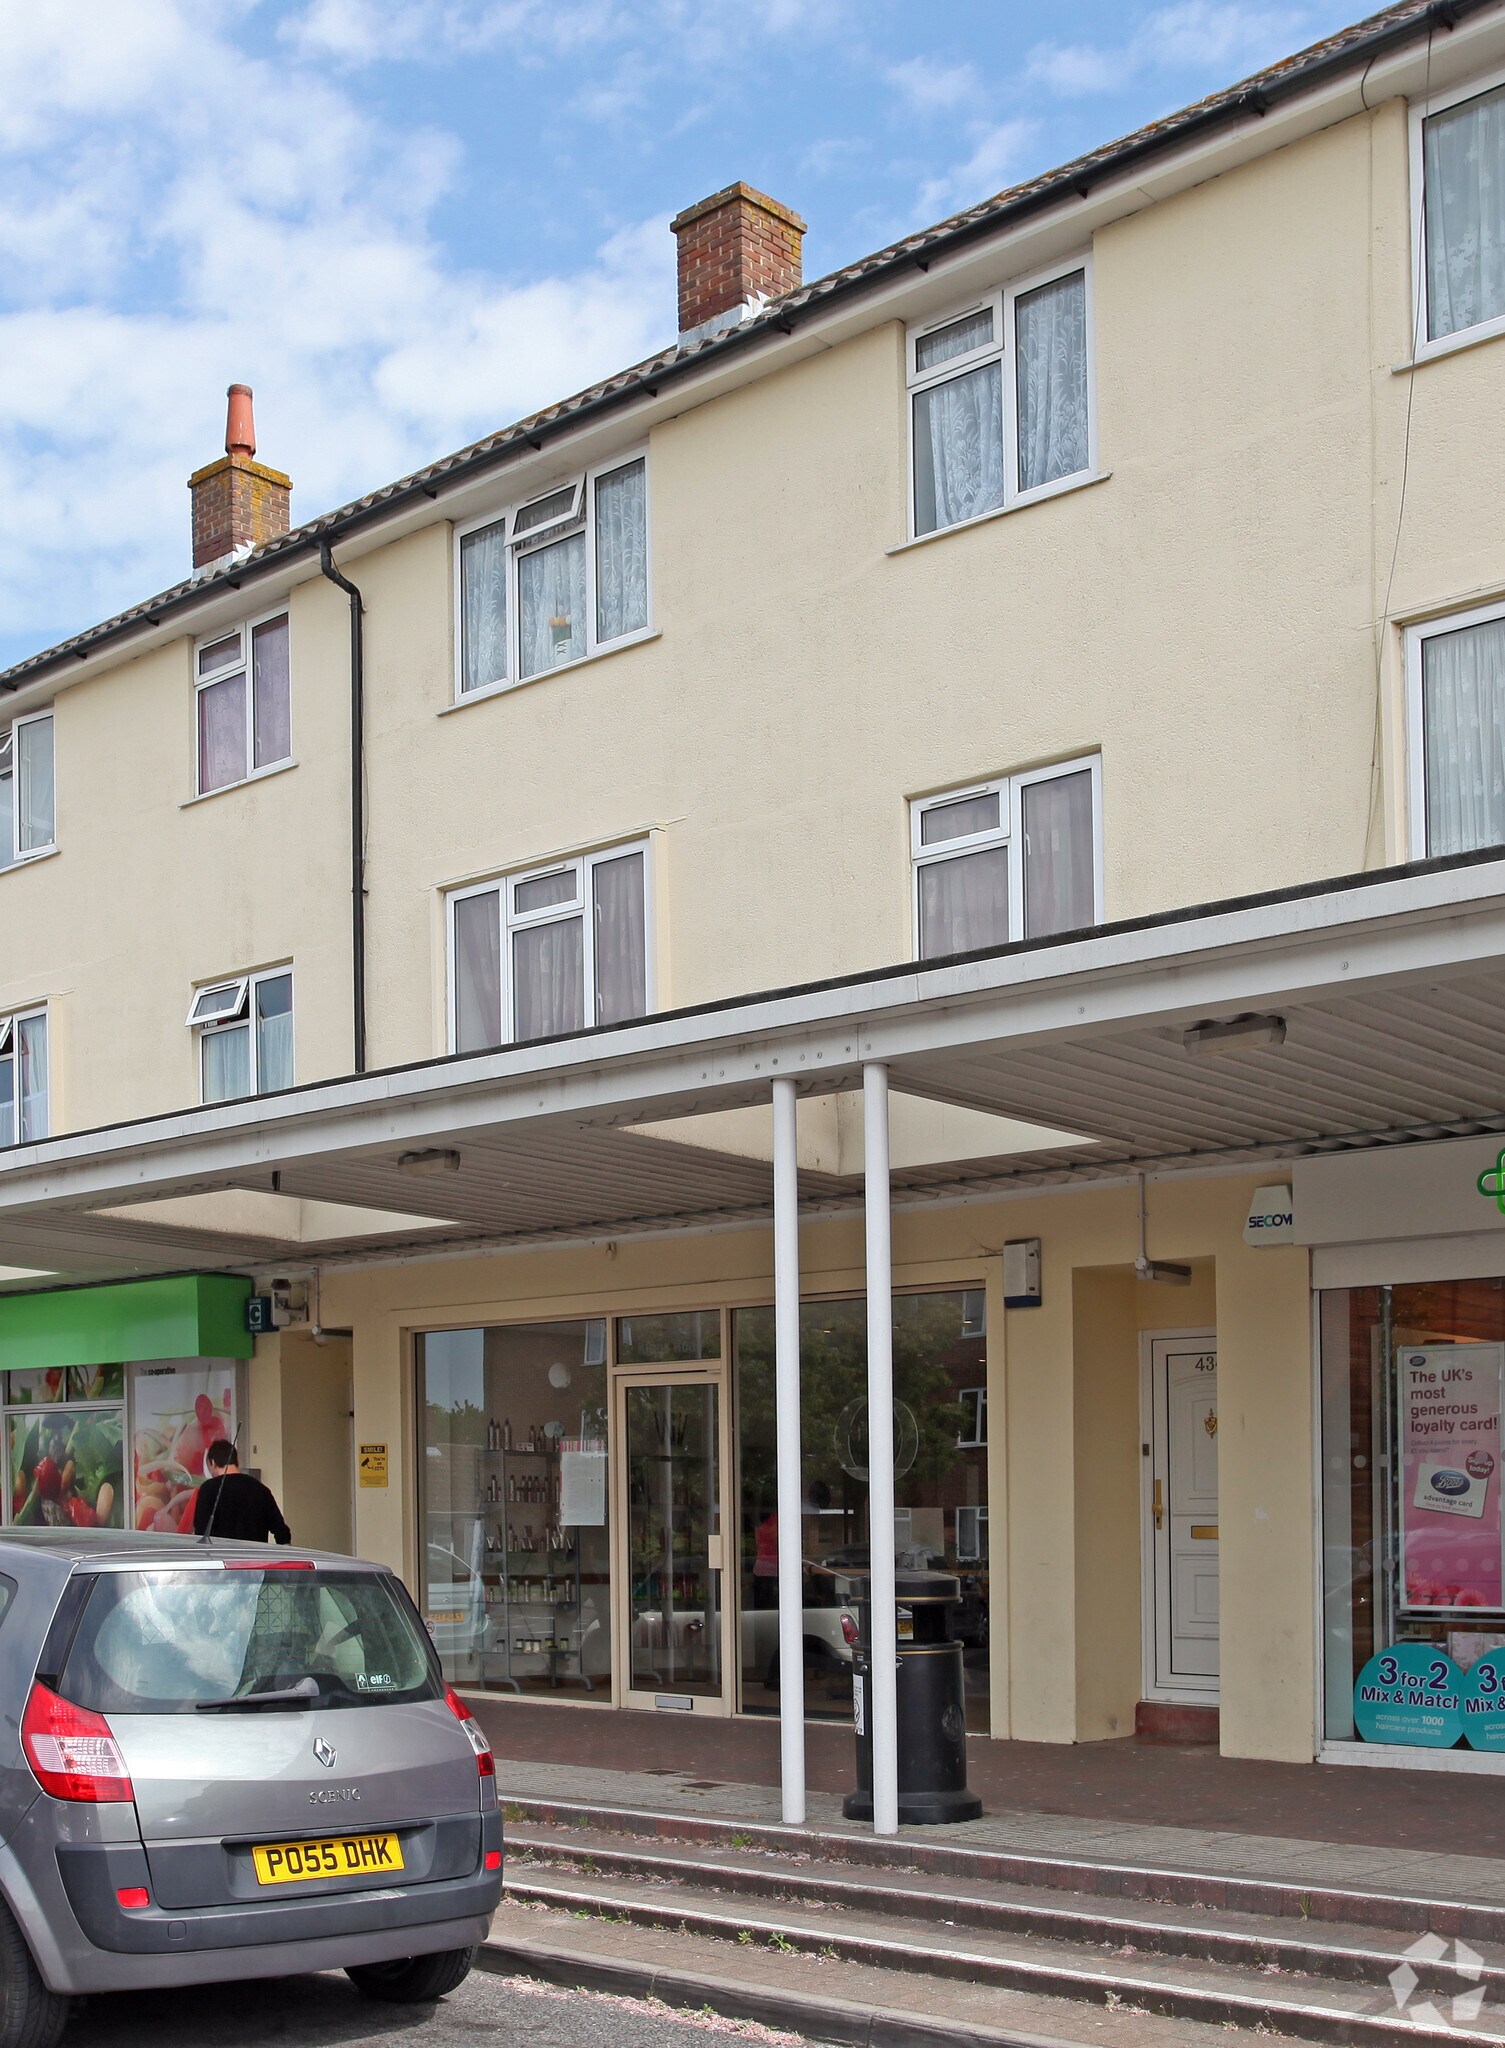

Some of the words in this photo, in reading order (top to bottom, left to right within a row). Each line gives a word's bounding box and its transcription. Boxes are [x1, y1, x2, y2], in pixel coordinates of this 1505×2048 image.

[1248, 1213, 1293, 1229] SECOM
[1195, 1355, 1218, 1372] 43
[1410, 1371, 1437, 1384] The
[1441, 1368, 1473, 1382] UK's
[1410, 1386, 1446, 1400] most
[1410, 1404, 1478, 1419] generous
[1411, 1420, 1455, 1435] loyalty
[1460, 1417, 1498, 1431] card!
[1423, 1494, 1457, 1506] advantage
[1458, 1500, 1473, 1508] card
[370, 1674, 383, 1684] elf
[1378, 1656, 1399, 1686] 3
[1400, 1671, 1427, 1688] for
[1428, 1660, 1450, 1691] 2
[1478, 1663, 1499, 1694] 3
[1361, 1686, 1390, 1703] Mix
[1393, 1690, 1405, 1705] &
[1465, 1697, 1495, 1714] Mix
[1376, 1713, 1400, 1721] across
[1421, 1715, 1445, 1727] 1000
[1484, 1722, 1505, 1731] acros
[1375, 1722, 1406, 1732] haircare
[1407, 1725, 1441, 1737] products
[309, 1788, 361, 1804] SCENIC
[266, 1844, 338, 1877] PO55
[342, 1838, 393, 1868] DHK
